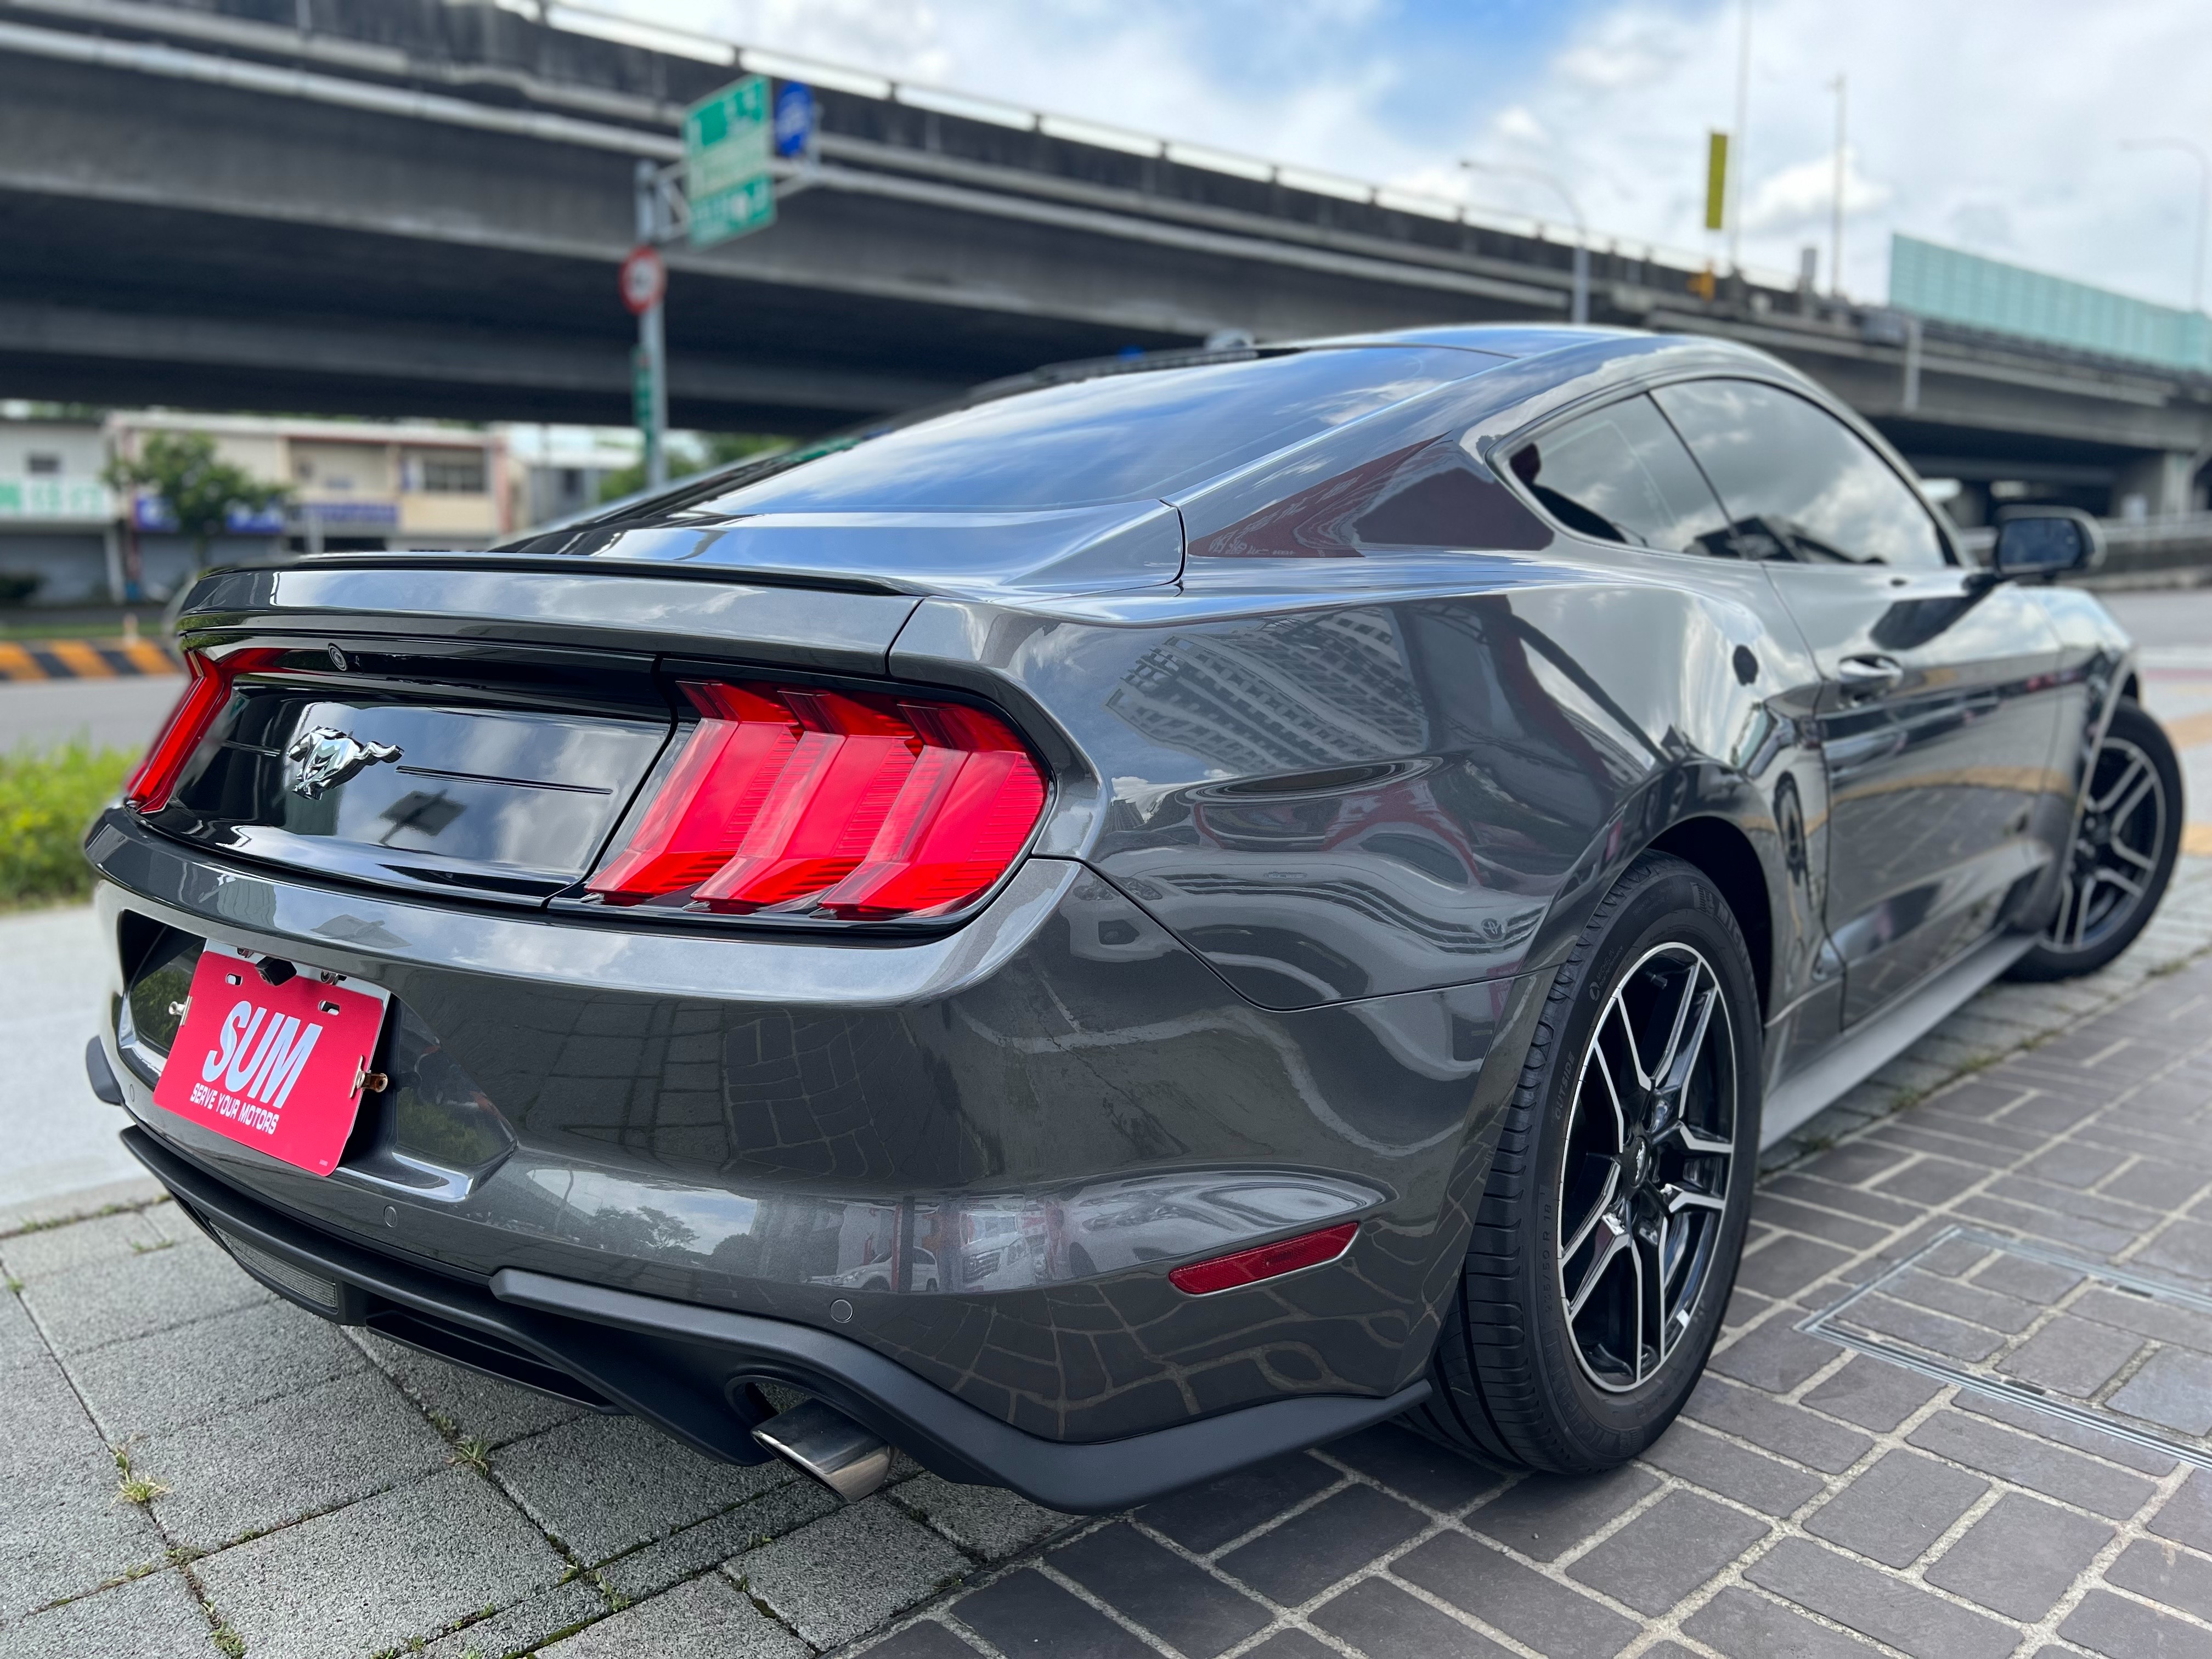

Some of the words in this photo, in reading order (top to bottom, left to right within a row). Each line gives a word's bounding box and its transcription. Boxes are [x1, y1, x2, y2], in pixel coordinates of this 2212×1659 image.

[202, 1001, 323, 1109] SUM
[1555, 1050, 1575, 1120] OUTSIDE
[190, 1082, 218, 1110] SERVE
[216, 1092, 241, 1120] YOUR
[238, 1102, 280, 1135] MOTORS
